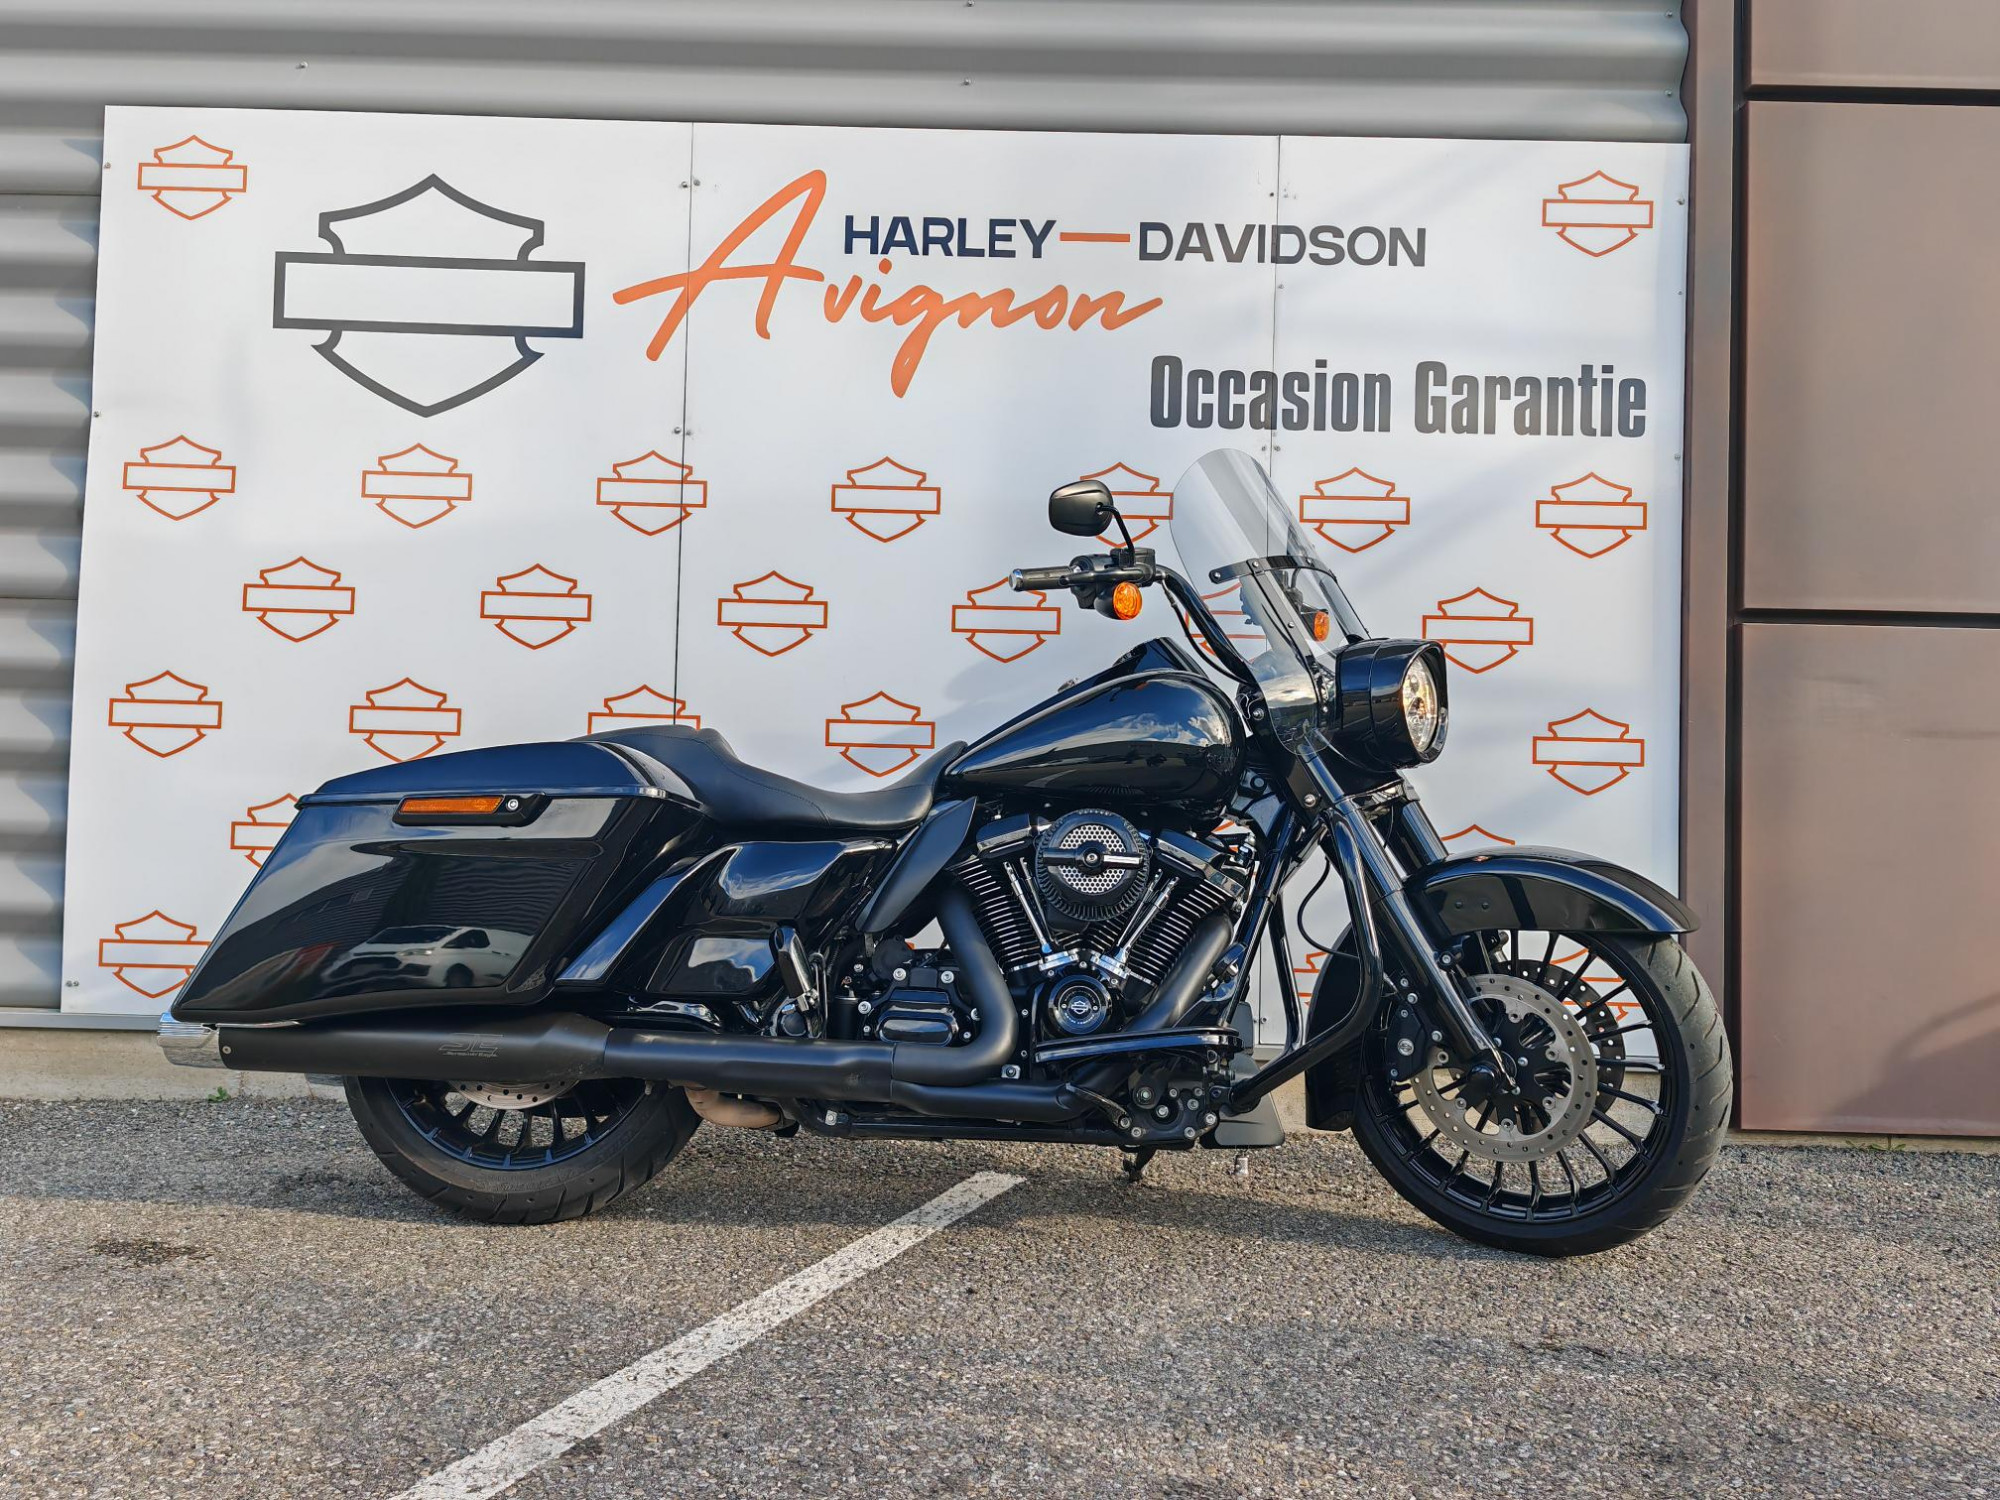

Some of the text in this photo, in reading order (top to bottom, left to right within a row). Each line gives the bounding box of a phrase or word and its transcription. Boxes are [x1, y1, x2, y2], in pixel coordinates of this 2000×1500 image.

[613, 170, 1163, 398] Avignon
[1149, 355, 1647, 438] Occasion Garantie
